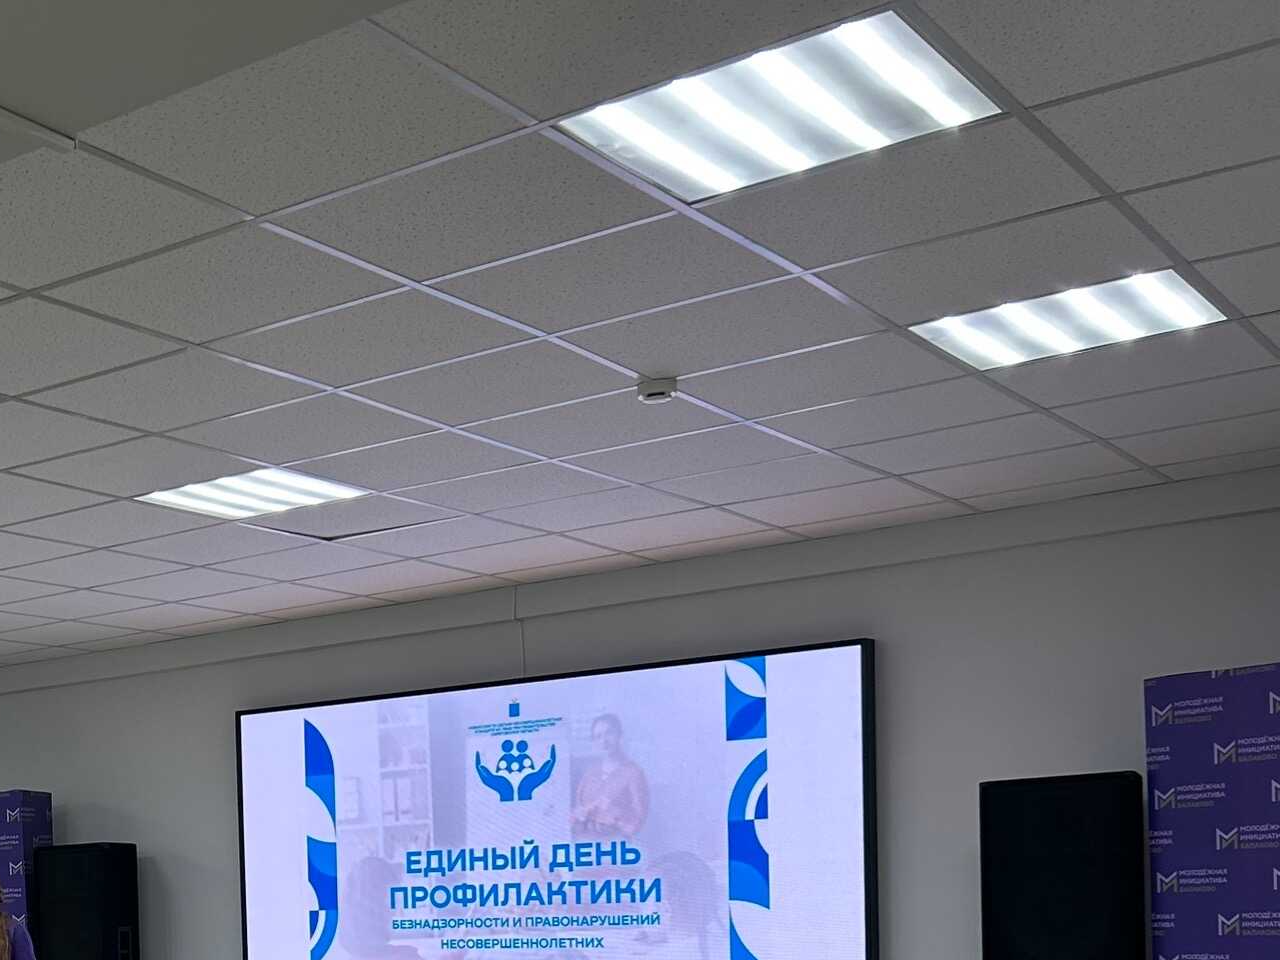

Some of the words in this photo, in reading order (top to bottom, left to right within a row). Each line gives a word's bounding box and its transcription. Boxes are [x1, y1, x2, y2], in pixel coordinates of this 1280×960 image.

[406, 840, 539, 877] ЕДИНЫЙ
[549, 841, 640, 872] ДЕНЬ
[390, 878, 662, 909] ПРОФИЛАКТИКИ
[392, 917, 510, 929] БЕЗНАДЗОРНОСТИ
[513, 918, 522, 927] И
[525, 912, 660, 927] ПРАВОНАРУШЕНИЙ
[441, 937, 604, 949] НЕСОВЕРШЕННОЛЕТНИХ
